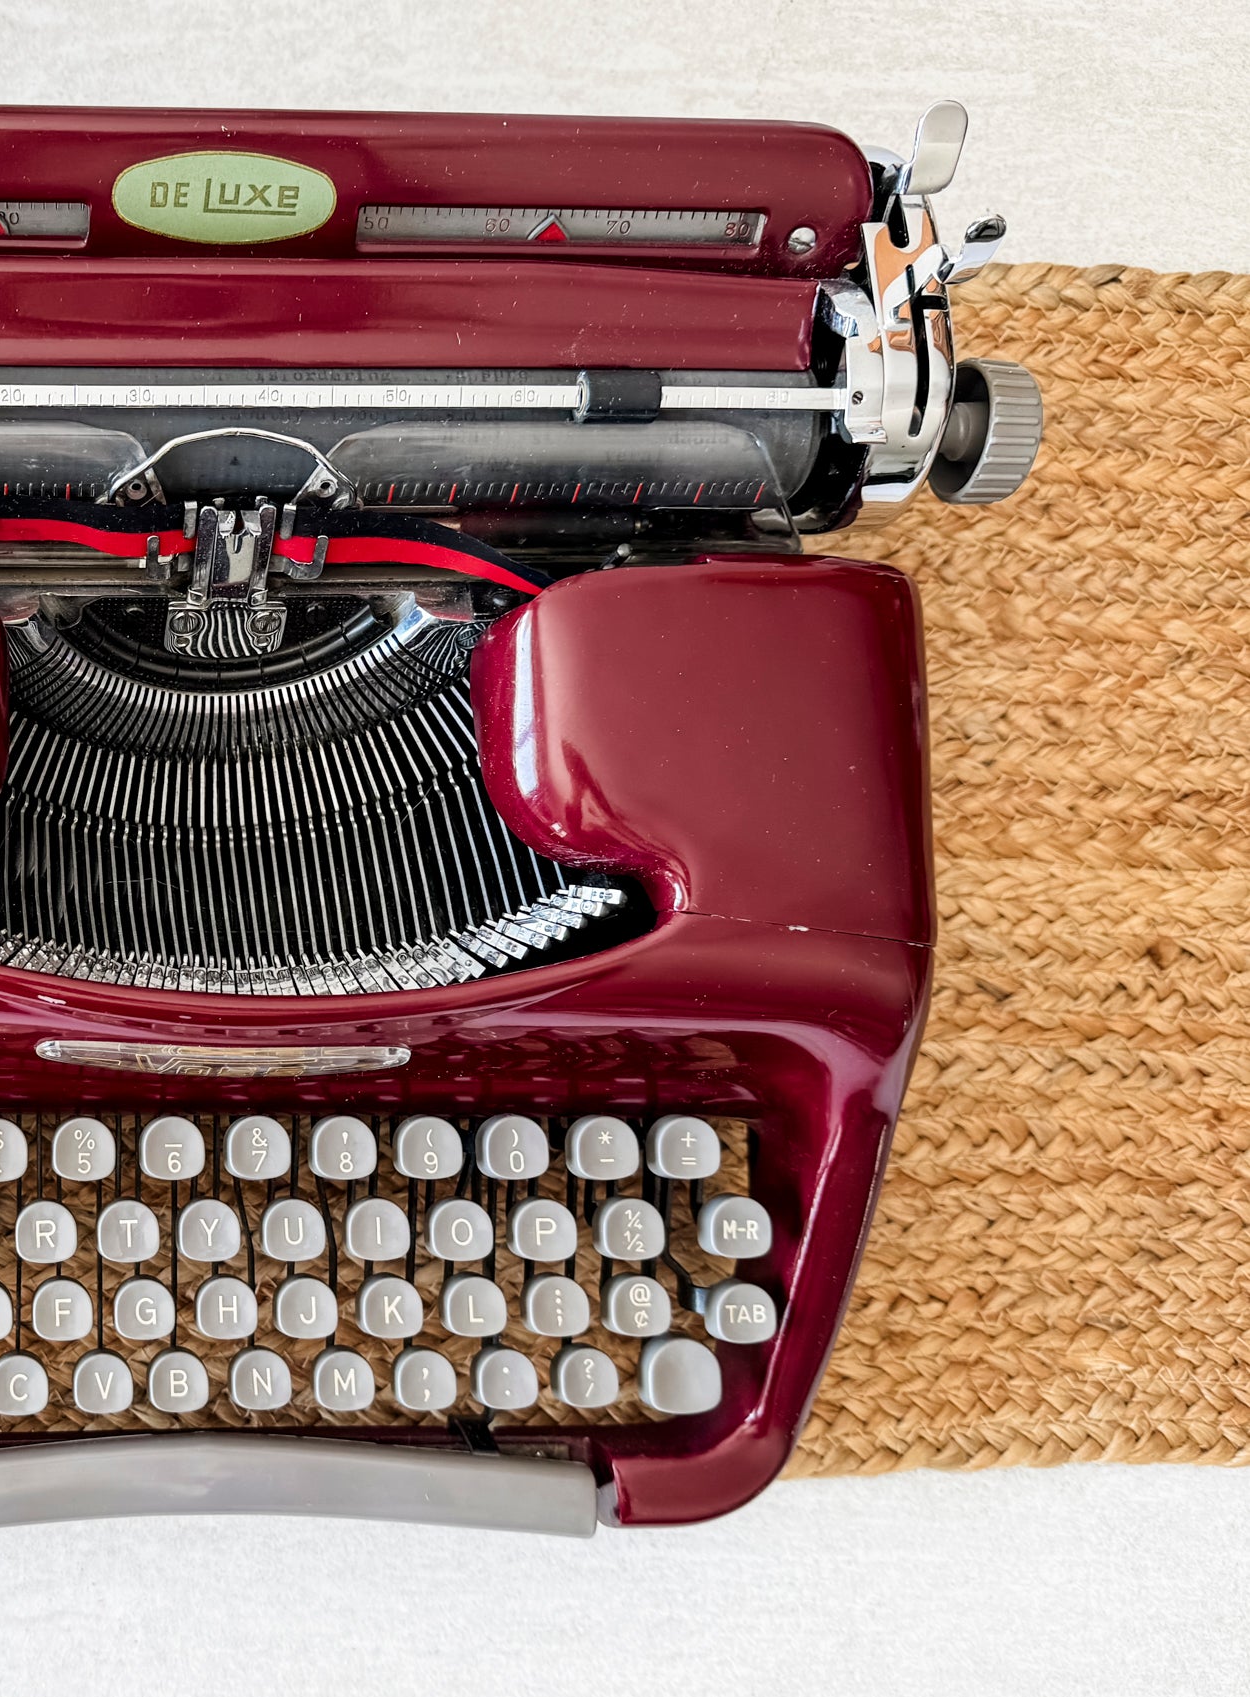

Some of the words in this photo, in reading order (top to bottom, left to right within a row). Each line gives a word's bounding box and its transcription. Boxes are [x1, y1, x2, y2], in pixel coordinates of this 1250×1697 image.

[150, 181, 190, 208] DE
[363, 215, 390, 231] 50
[484, 217, 511, 234] 60
[605, 220, 632, 236] 70
[724, 222, 750, 237] 80
[0, 388, 23, 402] 20
[127, 388, 152, 402] 30
[258, 389, 281, 402] 40
[385, 388, 408, 402] 50
[514, 389, 536, 402] 60
[78, 1153, 91, 1173] 5
[168, 1152, 181, 1173] 6
[252, 1151, 266, 1172] 7
[340, 1152, 353, 1172] 8
[424, 1152, 438, 1173] 9
[510, 1151, 524, 1172] 0
[36, 1220, 56, 1248] R
[120, 1220, 138, 1247] T
[200, 1219, 218, 1246] Y
[285, 1218, 303, 1245] U
[376, 1217, 381, 1244] I
[452, 1219, 473, 1246] O
[536, 1218, 556, 1245] P
[724, 1220, 758, 1240] M-R
[55, 1299, 71, 1326] F
[136, 1298, 156, 1324] G
[219, 1296, 237, 1323] H
[300, 1297, 316, 1324] J
[384, 1296, 403, 1324] K
[469, 1296, 484, 1322] L
[726, 1305, 767, 1323] TAB
[10, 1374, 27, 1401] C
[95, 1372, 113, 1399] V
[170, 1370, 188, 1397] B
[253, 1368, 272, 1395] N
[334, 1369, 355, 1395] M
